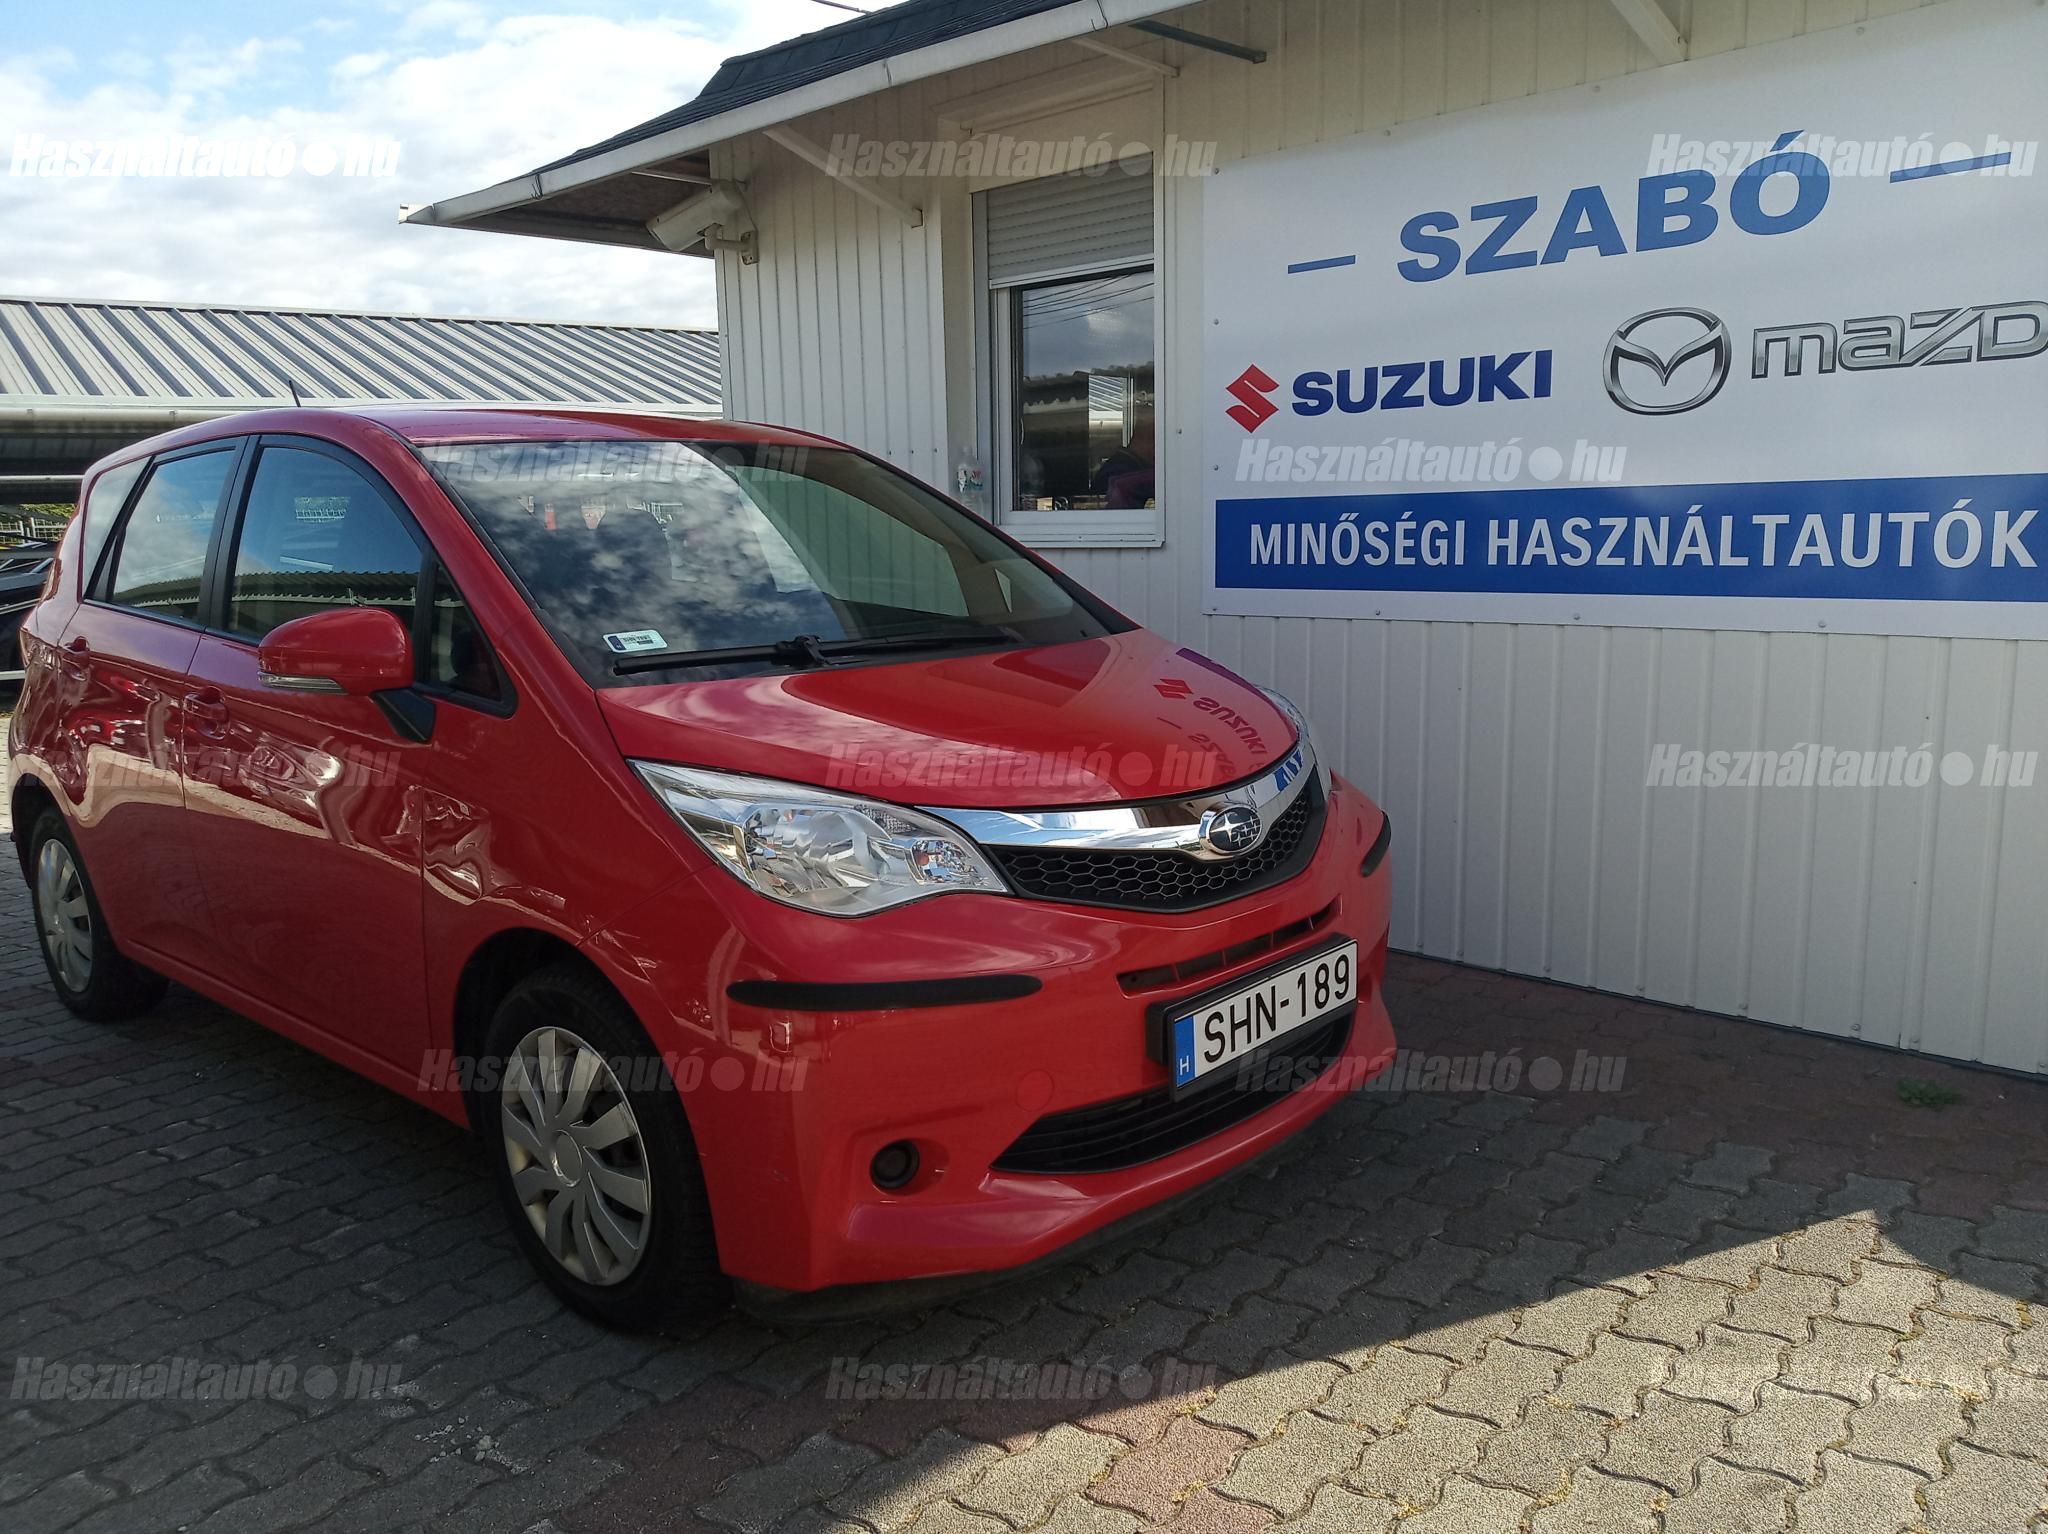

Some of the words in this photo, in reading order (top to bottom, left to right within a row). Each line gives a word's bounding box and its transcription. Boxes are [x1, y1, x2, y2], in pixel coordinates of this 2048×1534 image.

[1397, 129, 1830, 282] SZABÓ
[1291, 349, 1553, 417] SUZUKI
[1250, 511, 1465, 565] MINŐSÉGI
[1487, 498, 2039, 569] HASZNÁLTAUTÓK
[1204, 954, 1350, 1063] SHN-189
[1179, 1055, 1189, 1075] H
